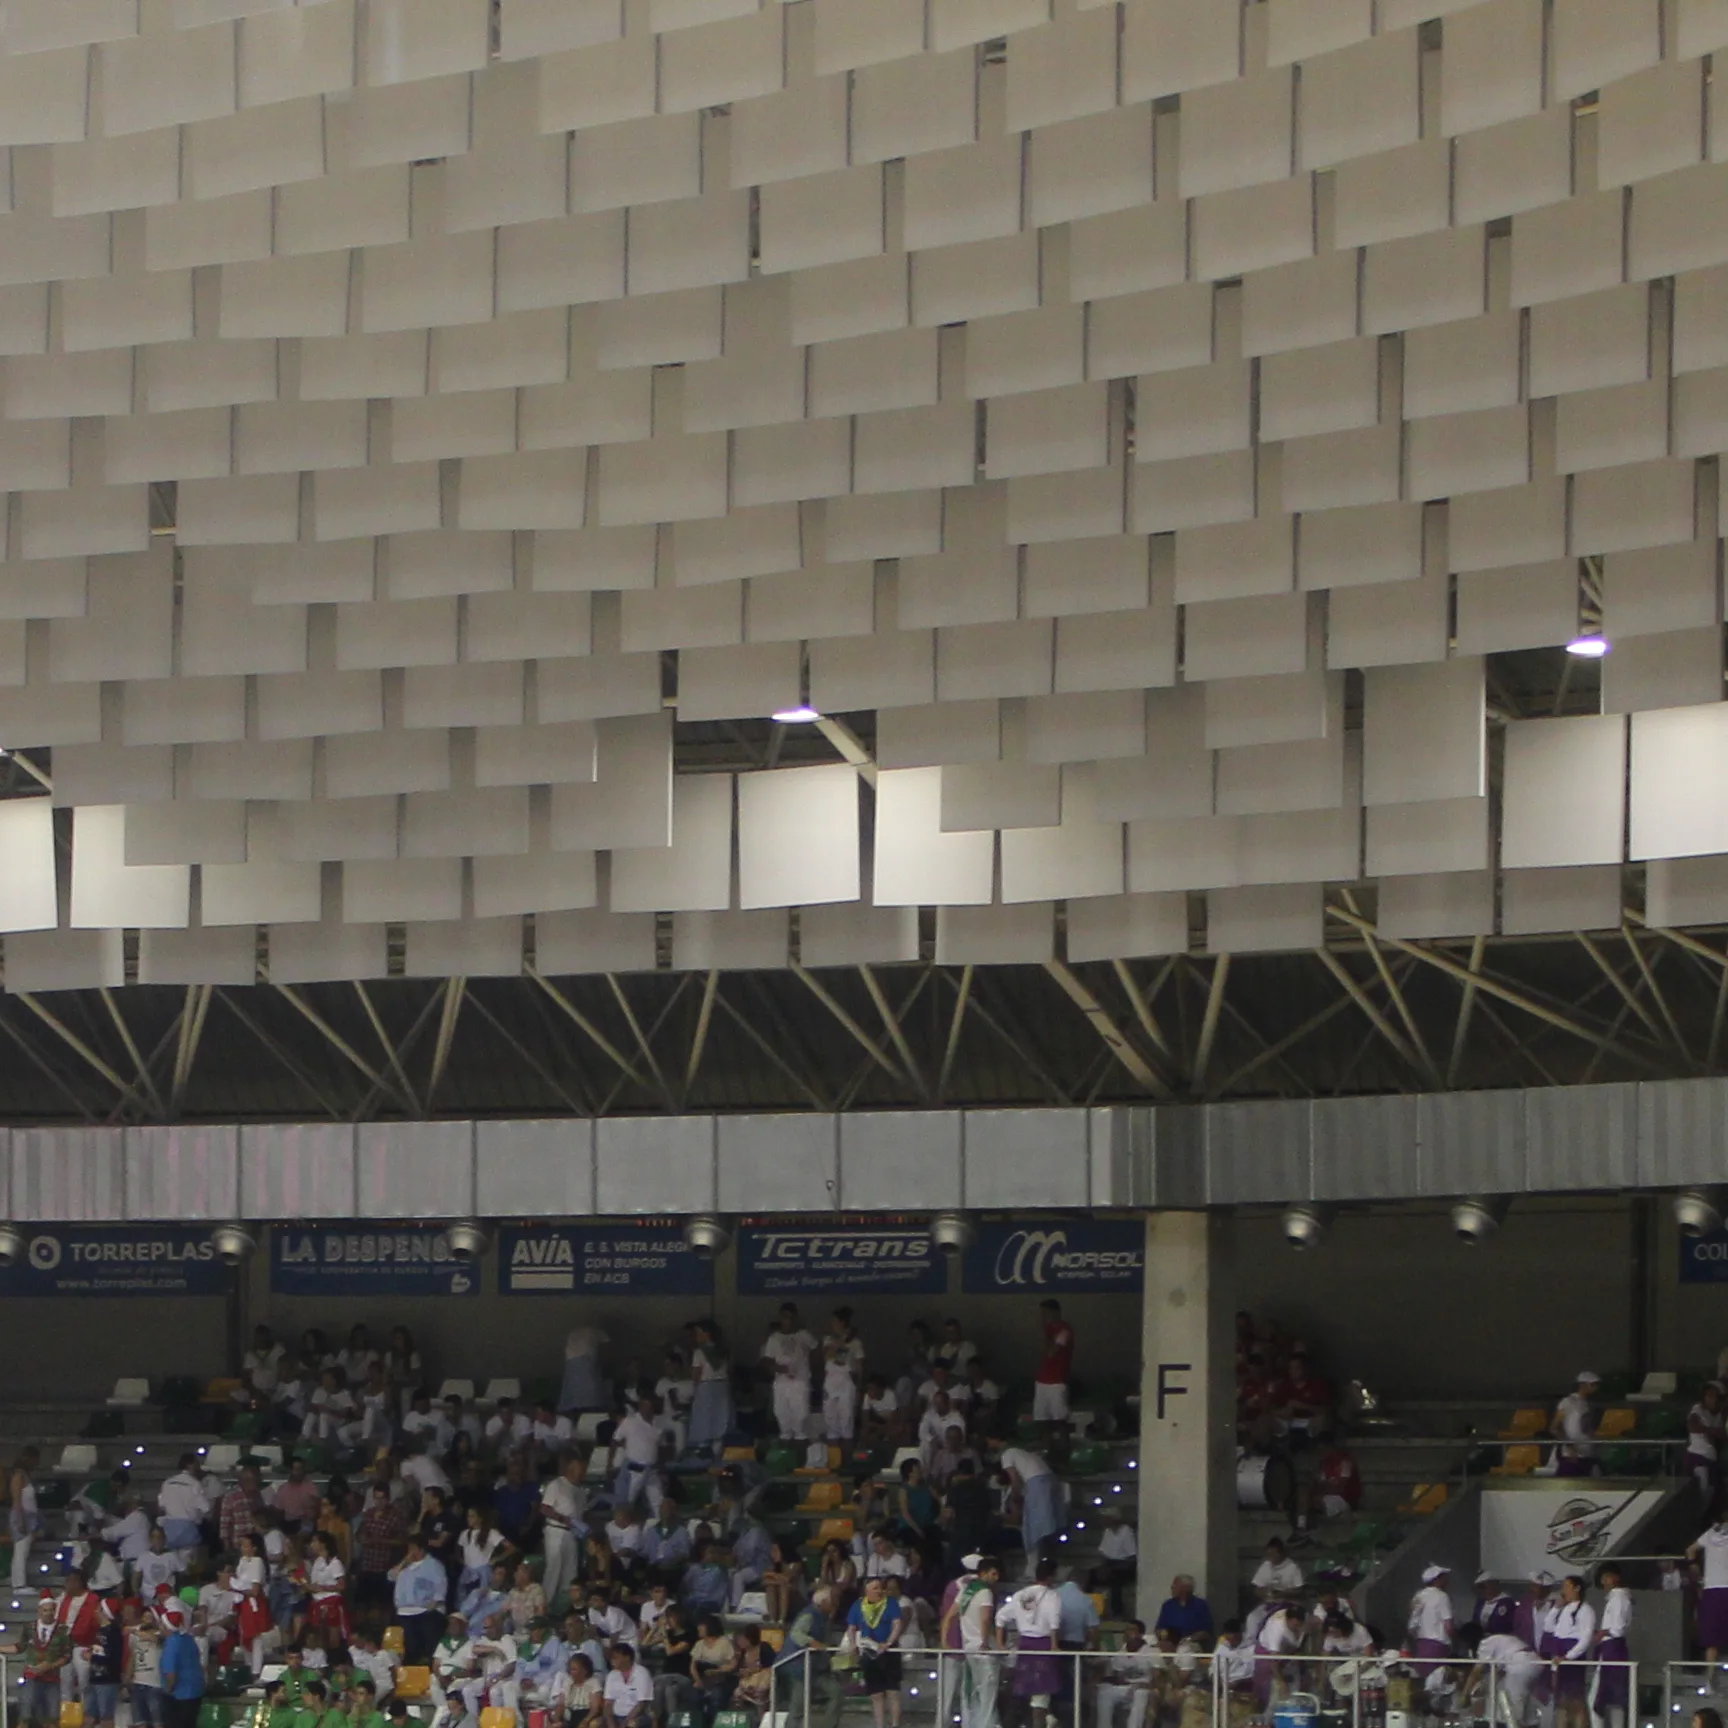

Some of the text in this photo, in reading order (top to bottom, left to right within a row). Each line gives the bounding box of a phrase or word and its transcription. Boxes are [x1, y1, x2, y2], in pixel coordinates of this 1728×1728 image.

[70, 1241, 214, 1262] TORREPLAS
[280, 1235, 318, 1263] LA
[613, 1241, 648, 1253] VISTA
[650, 1240, 688, 1253] ALEG
[584, 1257, 667, 1269] CON BURGOS
[1049, 1251, 1145, 1270] NORSOL
[584, 1273, 602, 1284] EN
[1157, 1364, 1191, 1420] F
